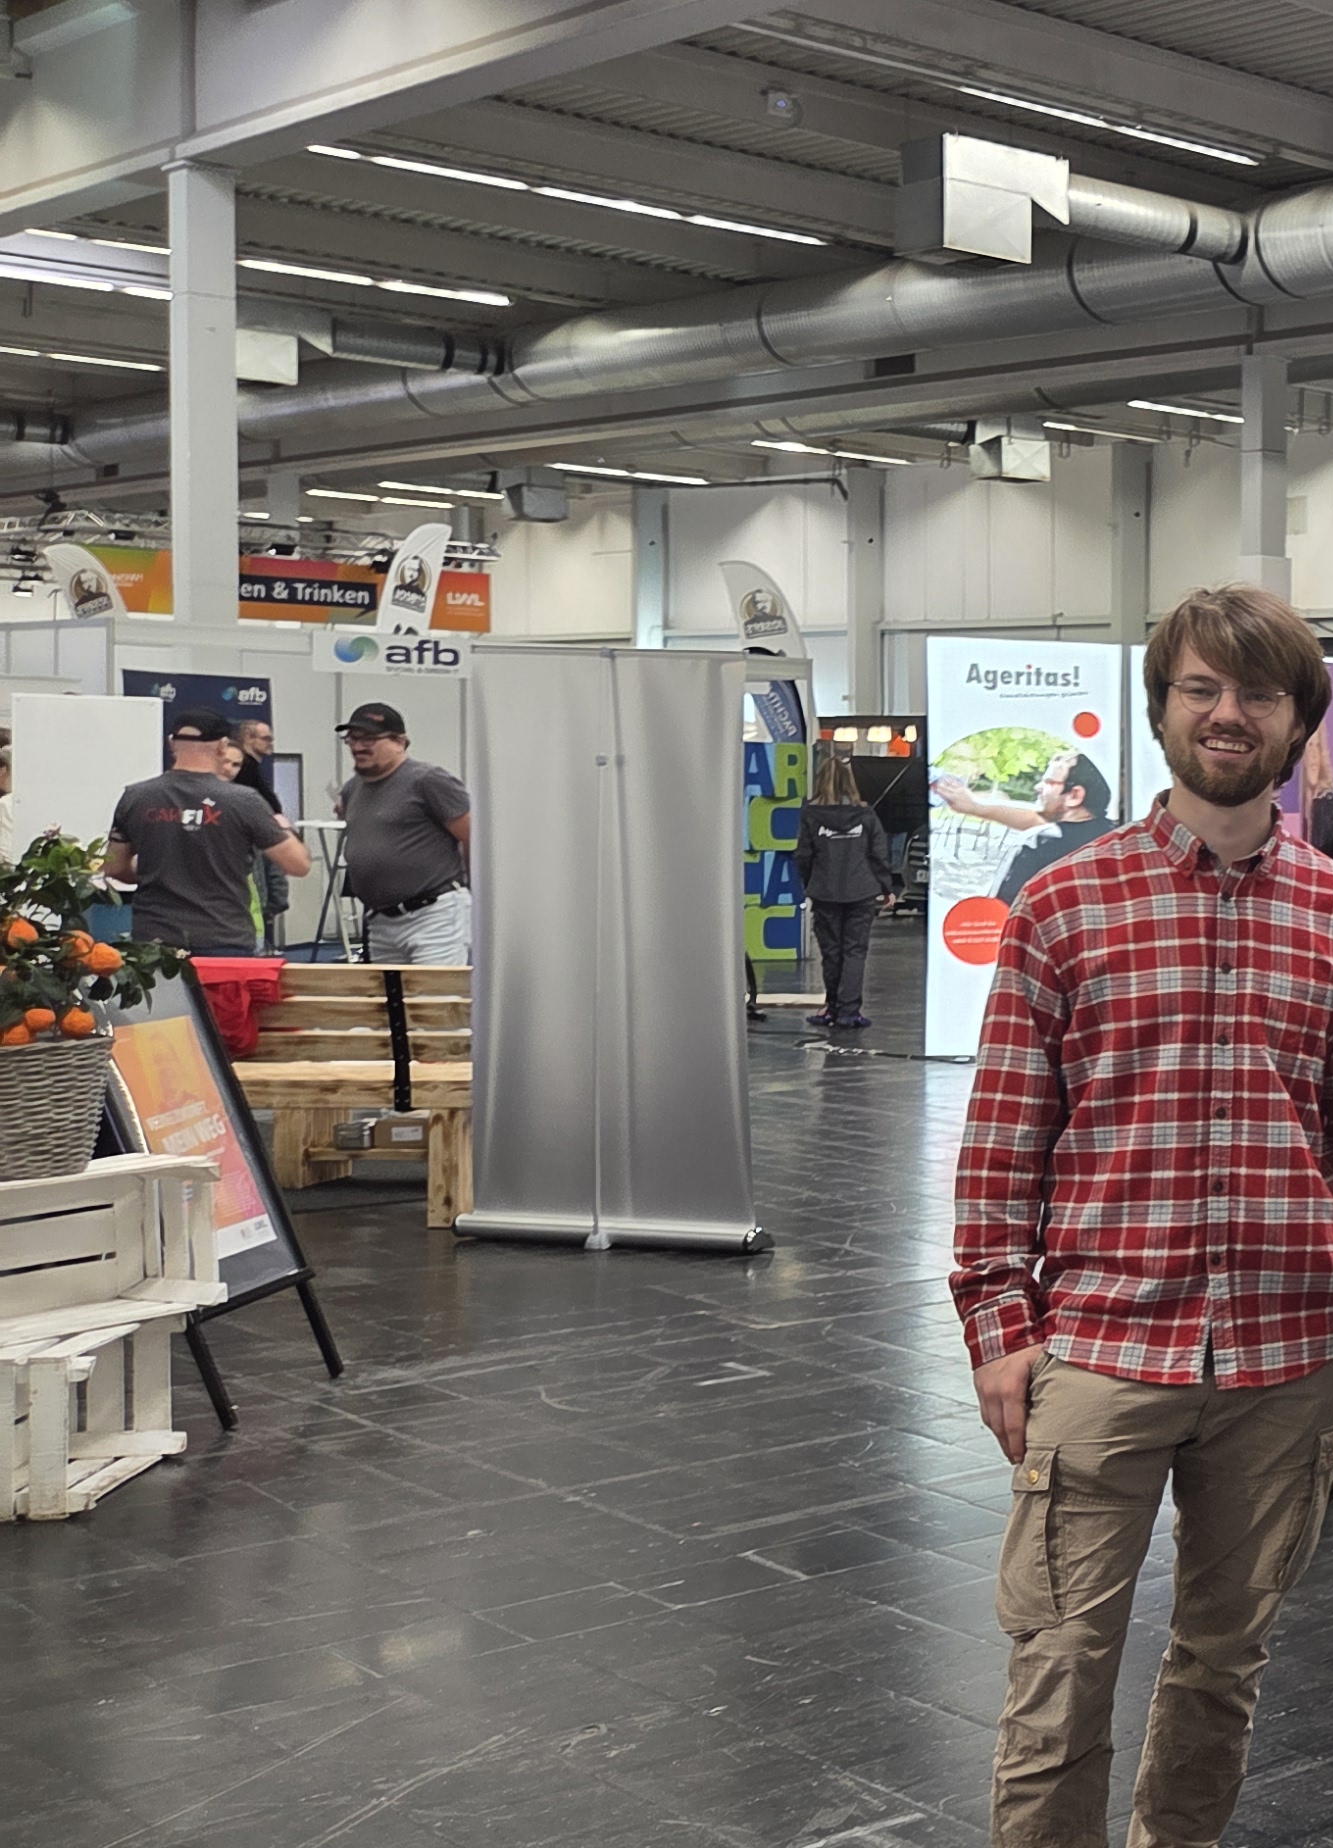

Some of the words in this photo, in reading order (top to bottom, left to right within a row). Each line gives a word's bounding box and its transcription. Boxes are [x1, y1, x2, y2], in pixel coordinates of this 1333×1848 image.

[272, 581, 289, 600] &
[293, 583, 370, 605] Trinken
[385, 639, 459, 667] afb
[965, 663, 1080, 691] Ageritas!
